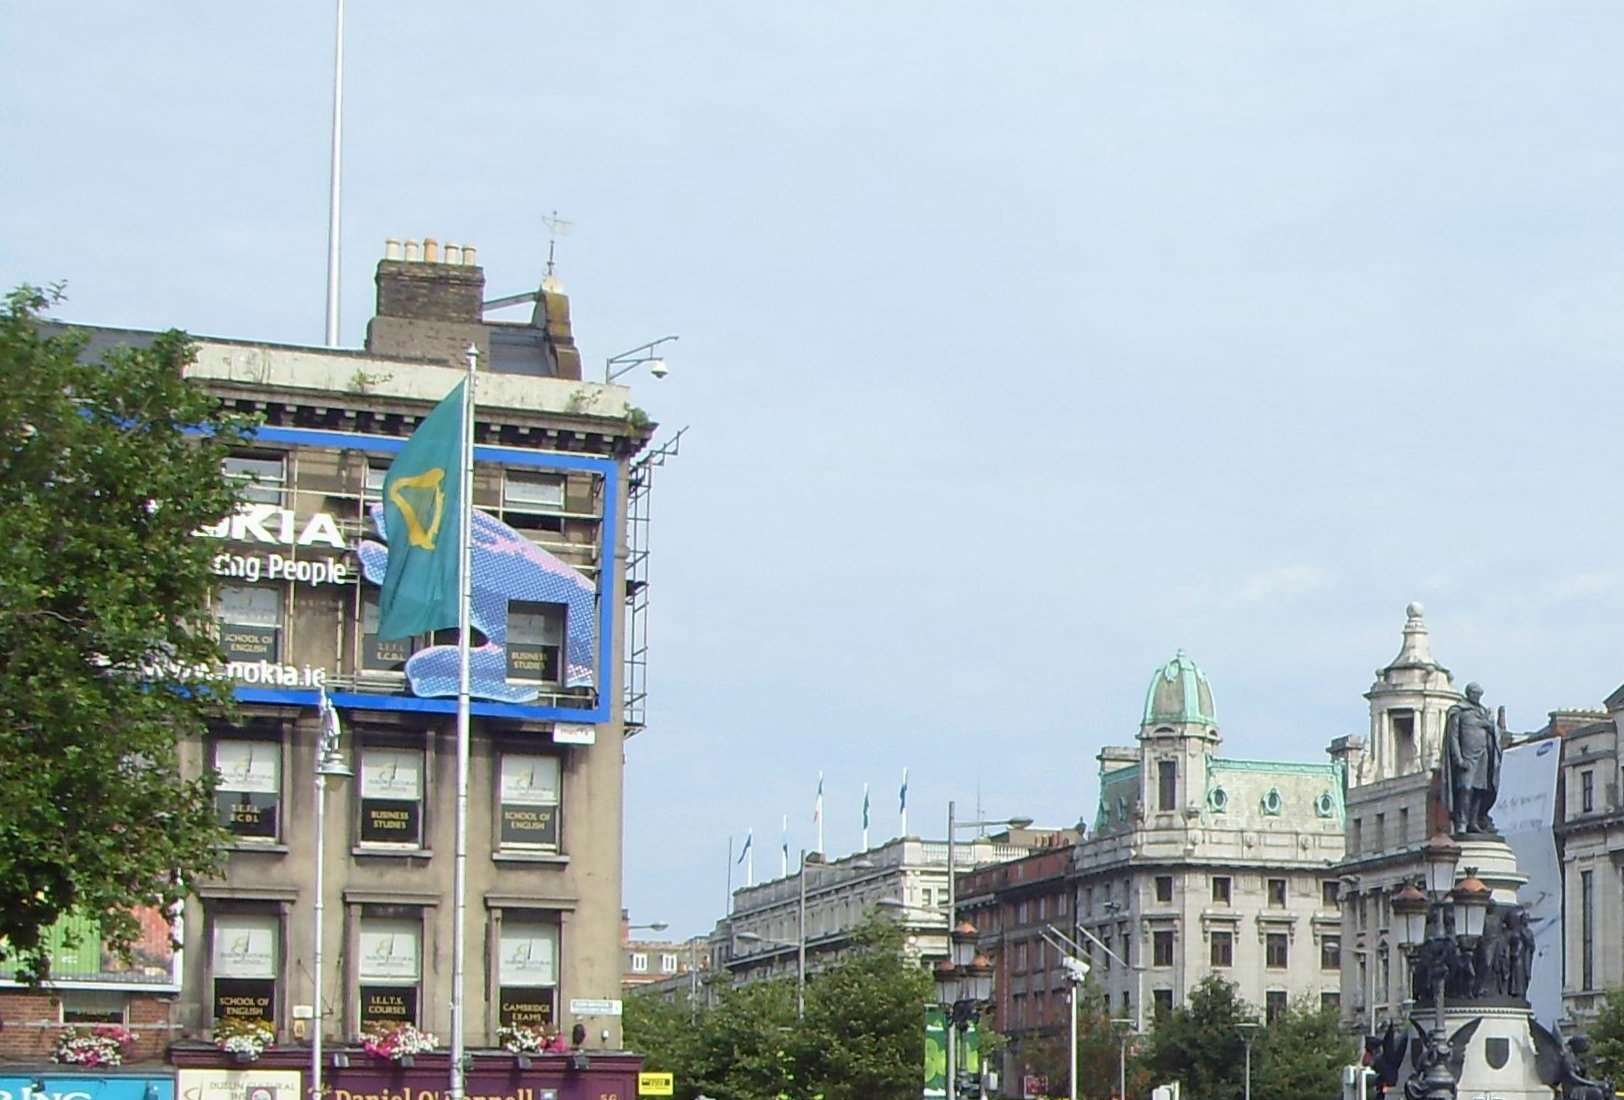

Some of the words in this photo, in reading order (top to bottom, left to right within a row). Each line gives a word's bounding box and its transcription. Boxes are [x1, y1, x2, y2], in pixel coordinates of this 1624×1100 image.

[190, 502, 346, 549] KIA
[269, 554, 347, 587] People
[511, 652, 547, 662] BUSINESS
[370, 811, 409, 820] BUSINESS
[504, 811, 537, 821] SCHOOL
[538, 812, 551, 821] OF
[373, 819, 407, 829] STUDIES
[511, 820, 545, 830] ENGLISH
[219, 997, 255, 1006] SCHOOL
[256, 997, 270, 1006] OF
[226, 1006, 264, 1016] ENGLISH
[368, 1005, 406, 1015] COURSES
[502, 1003, 550, 1013] CAMBRIDGE
[511, 1012, 542, 1022] EXAMS
